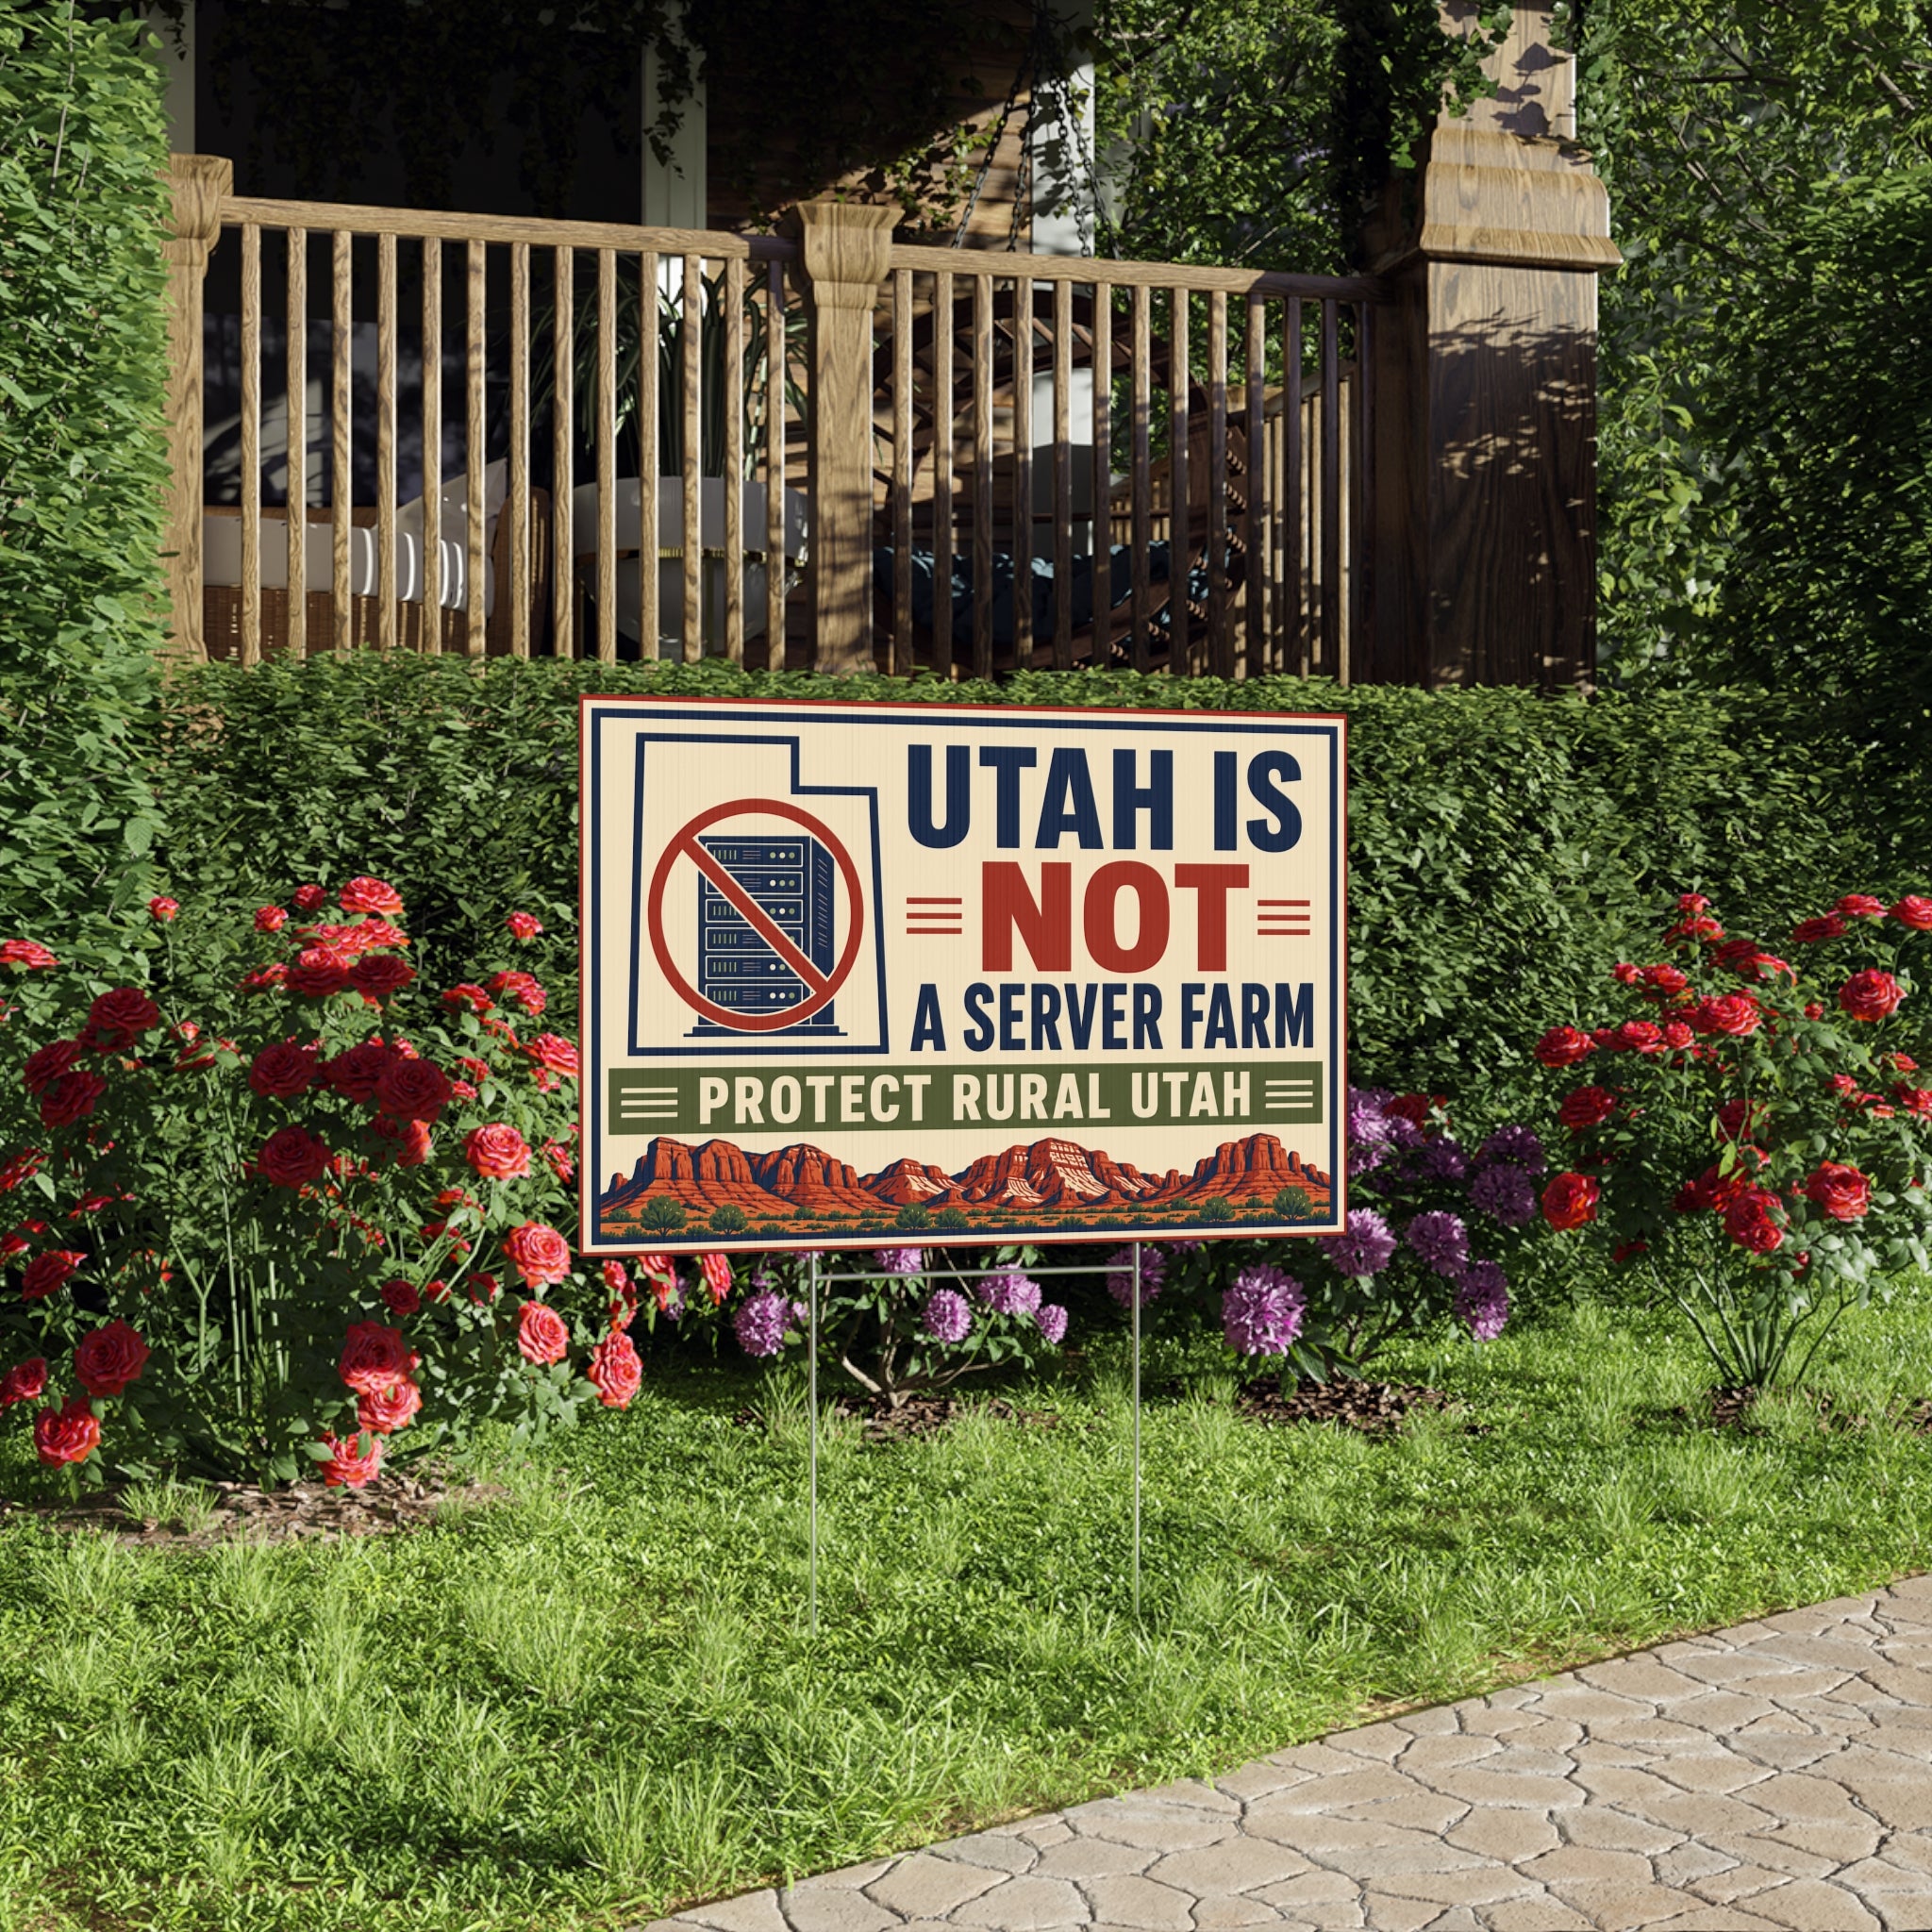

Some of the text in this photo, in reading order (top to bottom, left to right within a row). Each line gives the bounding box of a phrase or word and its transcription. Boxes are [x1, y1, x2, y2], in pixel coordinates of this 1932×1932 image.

[908, 743, 1302, 853] UTAH IS
[982, 860, 1249, 974] NOT
[910, 983, 1314, 1052] A SERVER FARM
[699, 1072, 1251, 1124] PROTECT RURAL UTAH
